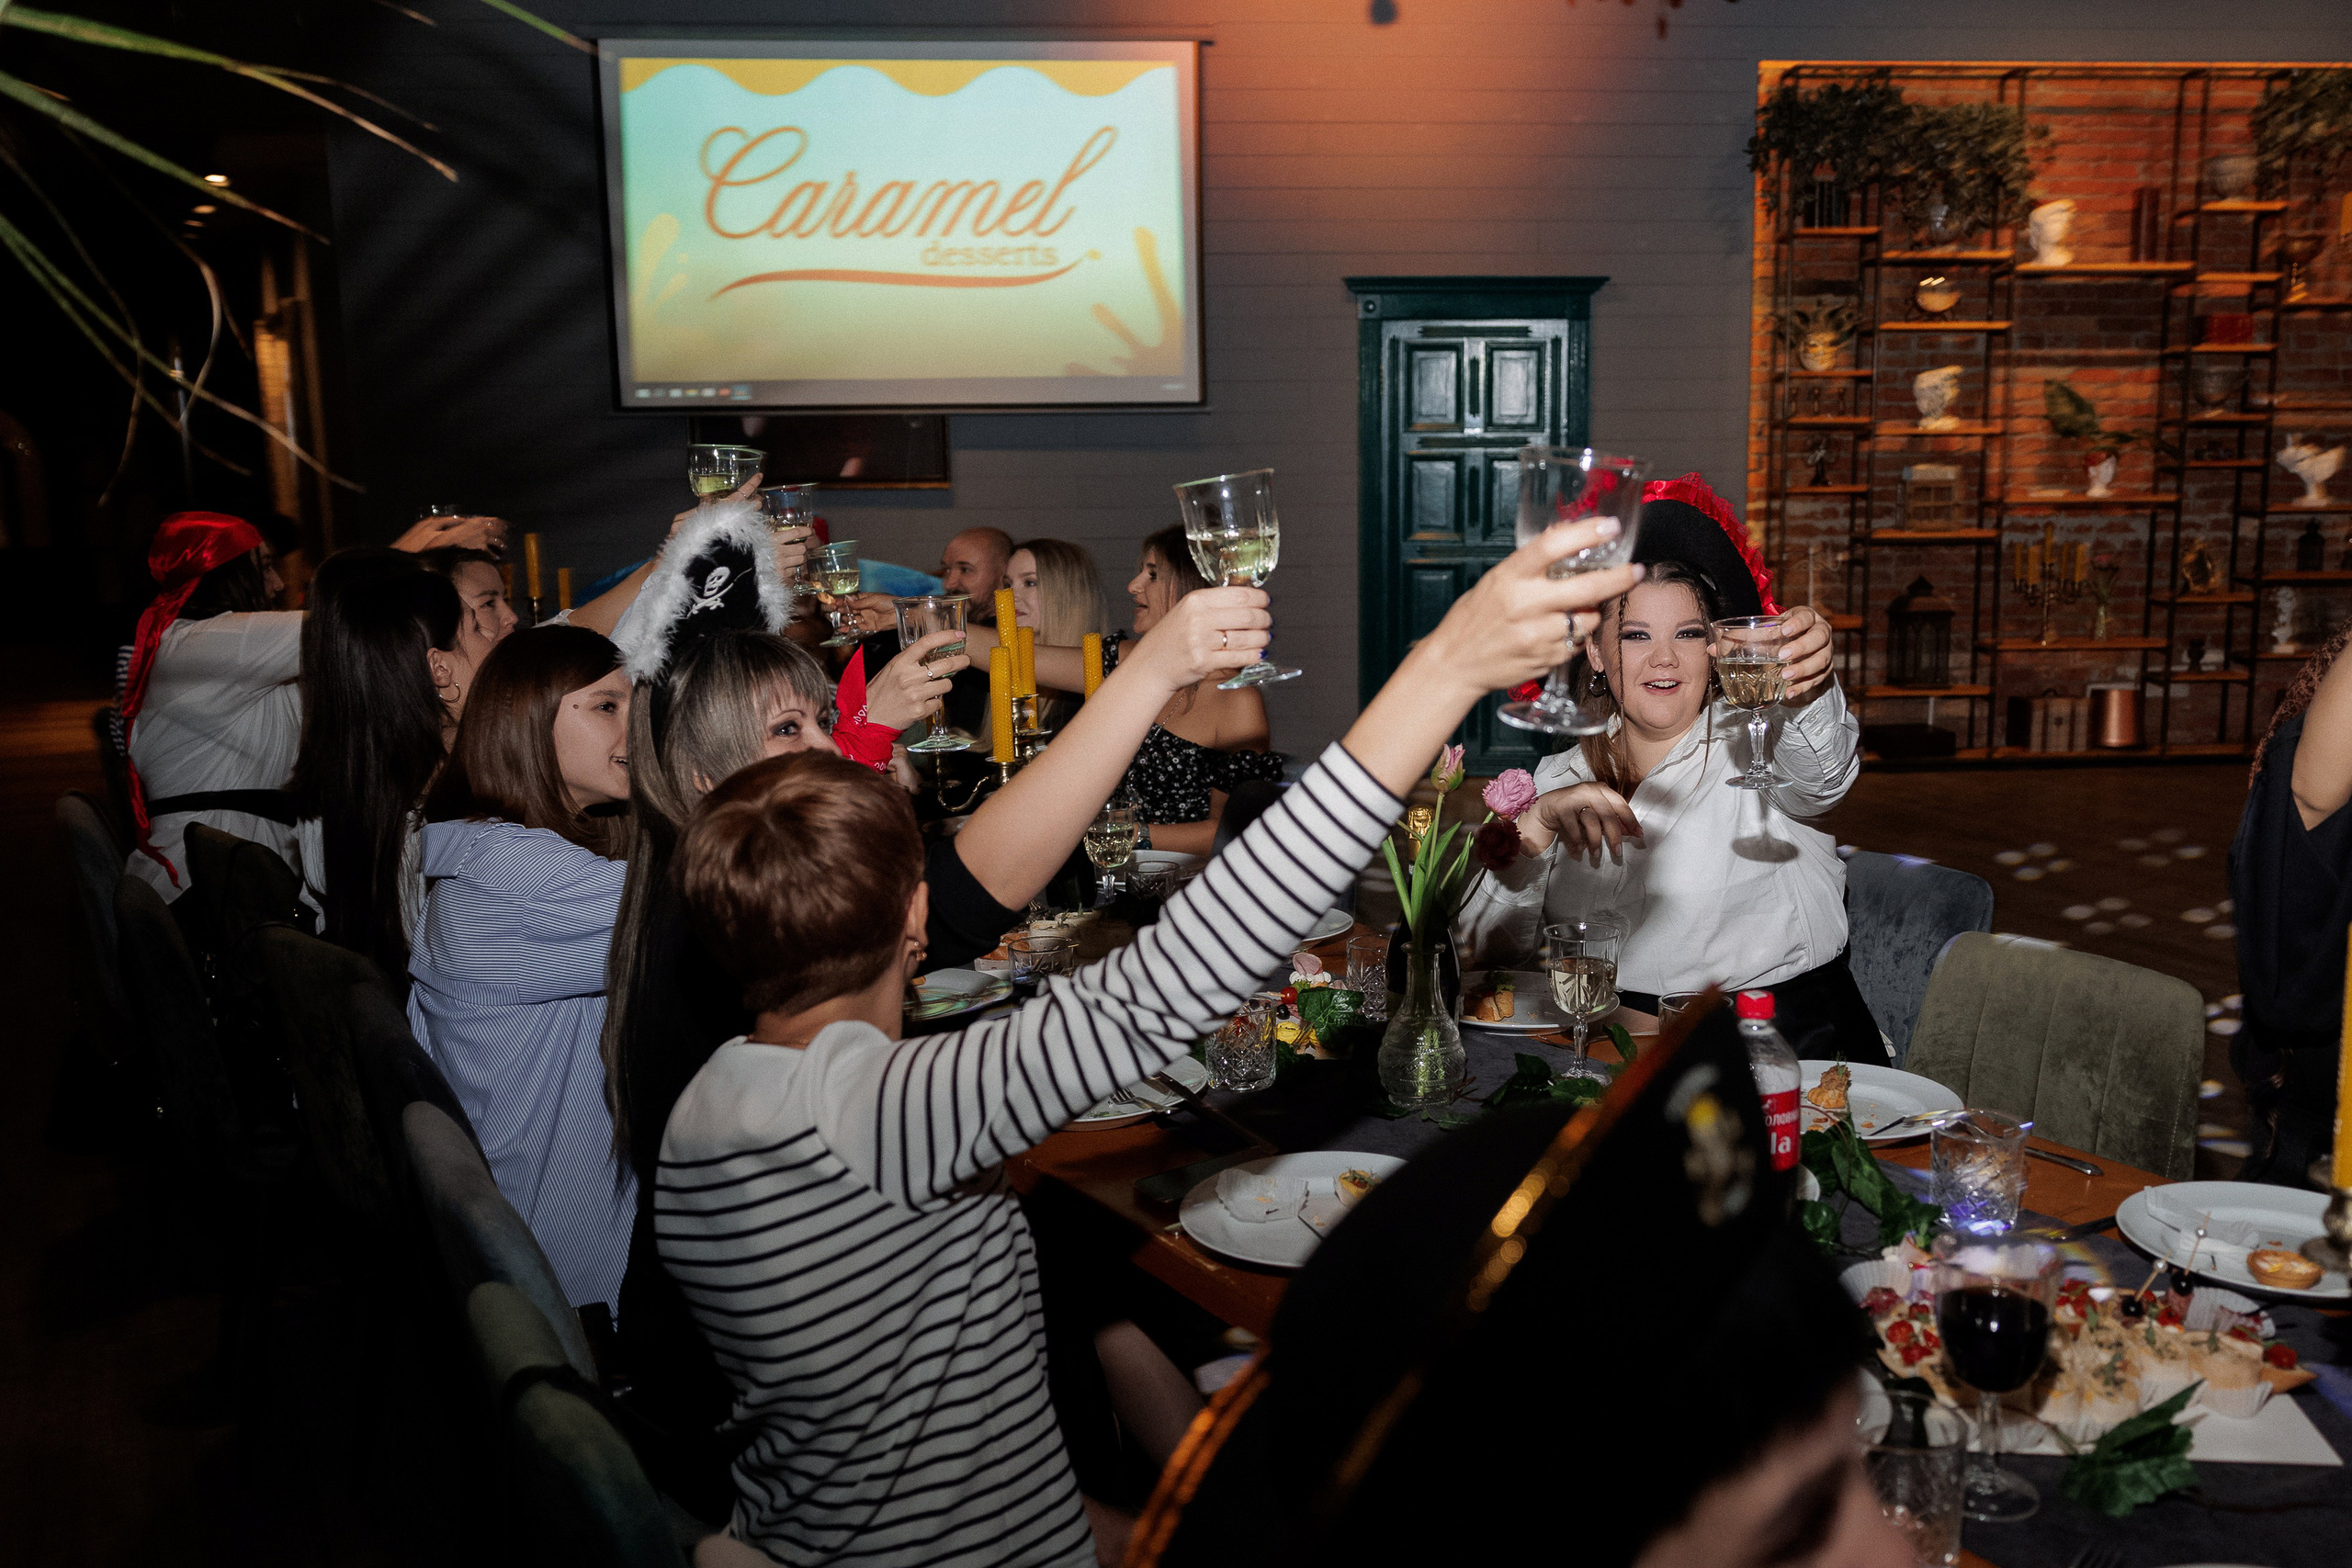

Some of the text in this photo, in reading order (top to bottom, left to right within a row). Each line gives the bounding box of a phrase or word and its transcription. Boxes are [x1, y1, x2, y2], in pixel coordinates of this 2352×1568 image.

[699, 126, 1118, 239] Caramel
[921, 240, 1057, 266] desserts
[1770, 1131, 1792, 1155] la
